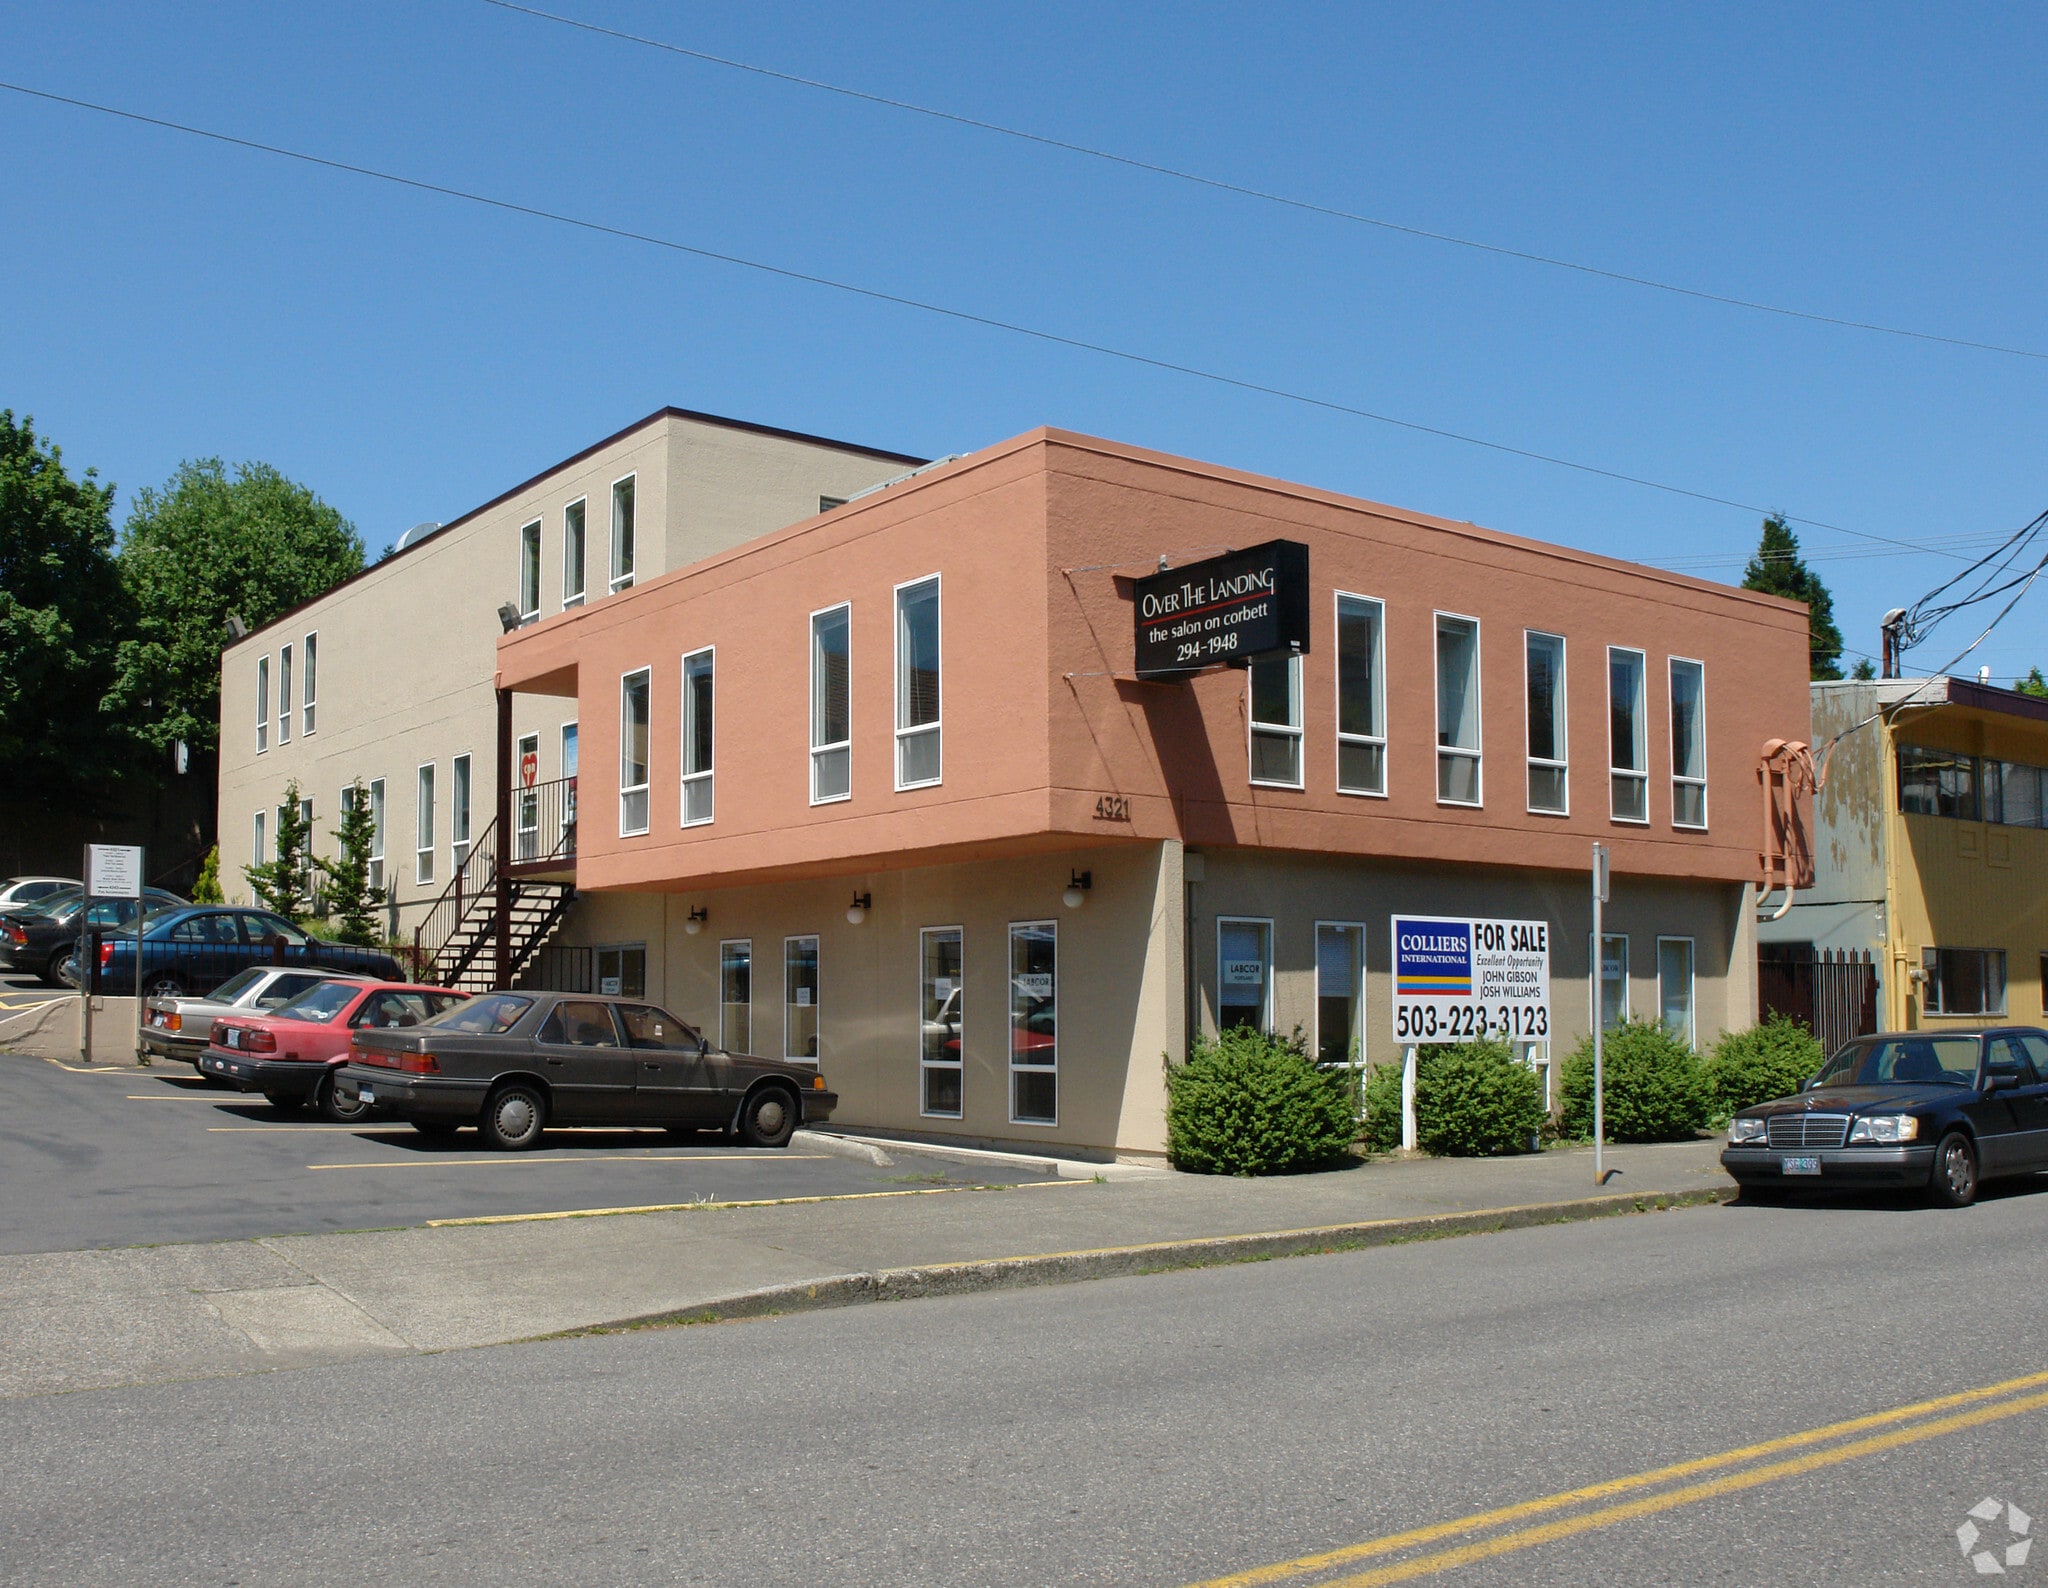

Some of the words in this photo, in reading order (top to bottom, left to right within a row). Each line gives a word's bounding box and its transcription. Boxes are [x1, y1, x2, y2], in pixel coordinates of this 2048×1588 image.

[1142, 592, 1180, 618] OVER
[1181, 582, 1206, 609] THE
[1149, 626, 1168, 644] the
[1171, 620, 1201, 639] salon
[1204, 615, 1220, 631] on
[1223, 603, 1268, 626] corbett
[1176, 632, 1238, 662] 294-1948
[1096, 796, 1128, 818] 4321
[1401, 934, 1467, 952] COLLIERS
[1474, 923, 1506, 951] FOR
[1510, 924, 1546, 952] SALE
[1230, 964, 1260, 973] LABCOR
[1401, 954, 1467, 964] INTERNATIONAL
[1476, 953, 1506, 967] Excellent
[1507, 955, 1544, 970] Opportunity
[1482, 971, 1505, 984] JOHN
[1506, 971, 1538, 983] GIBSON
[1480, 986, 1501, 1000] JOSH
[1502, 986, 1541, 998] WILLIAMS
[1397, 1005, 1548, 1037] 503-223-3123
